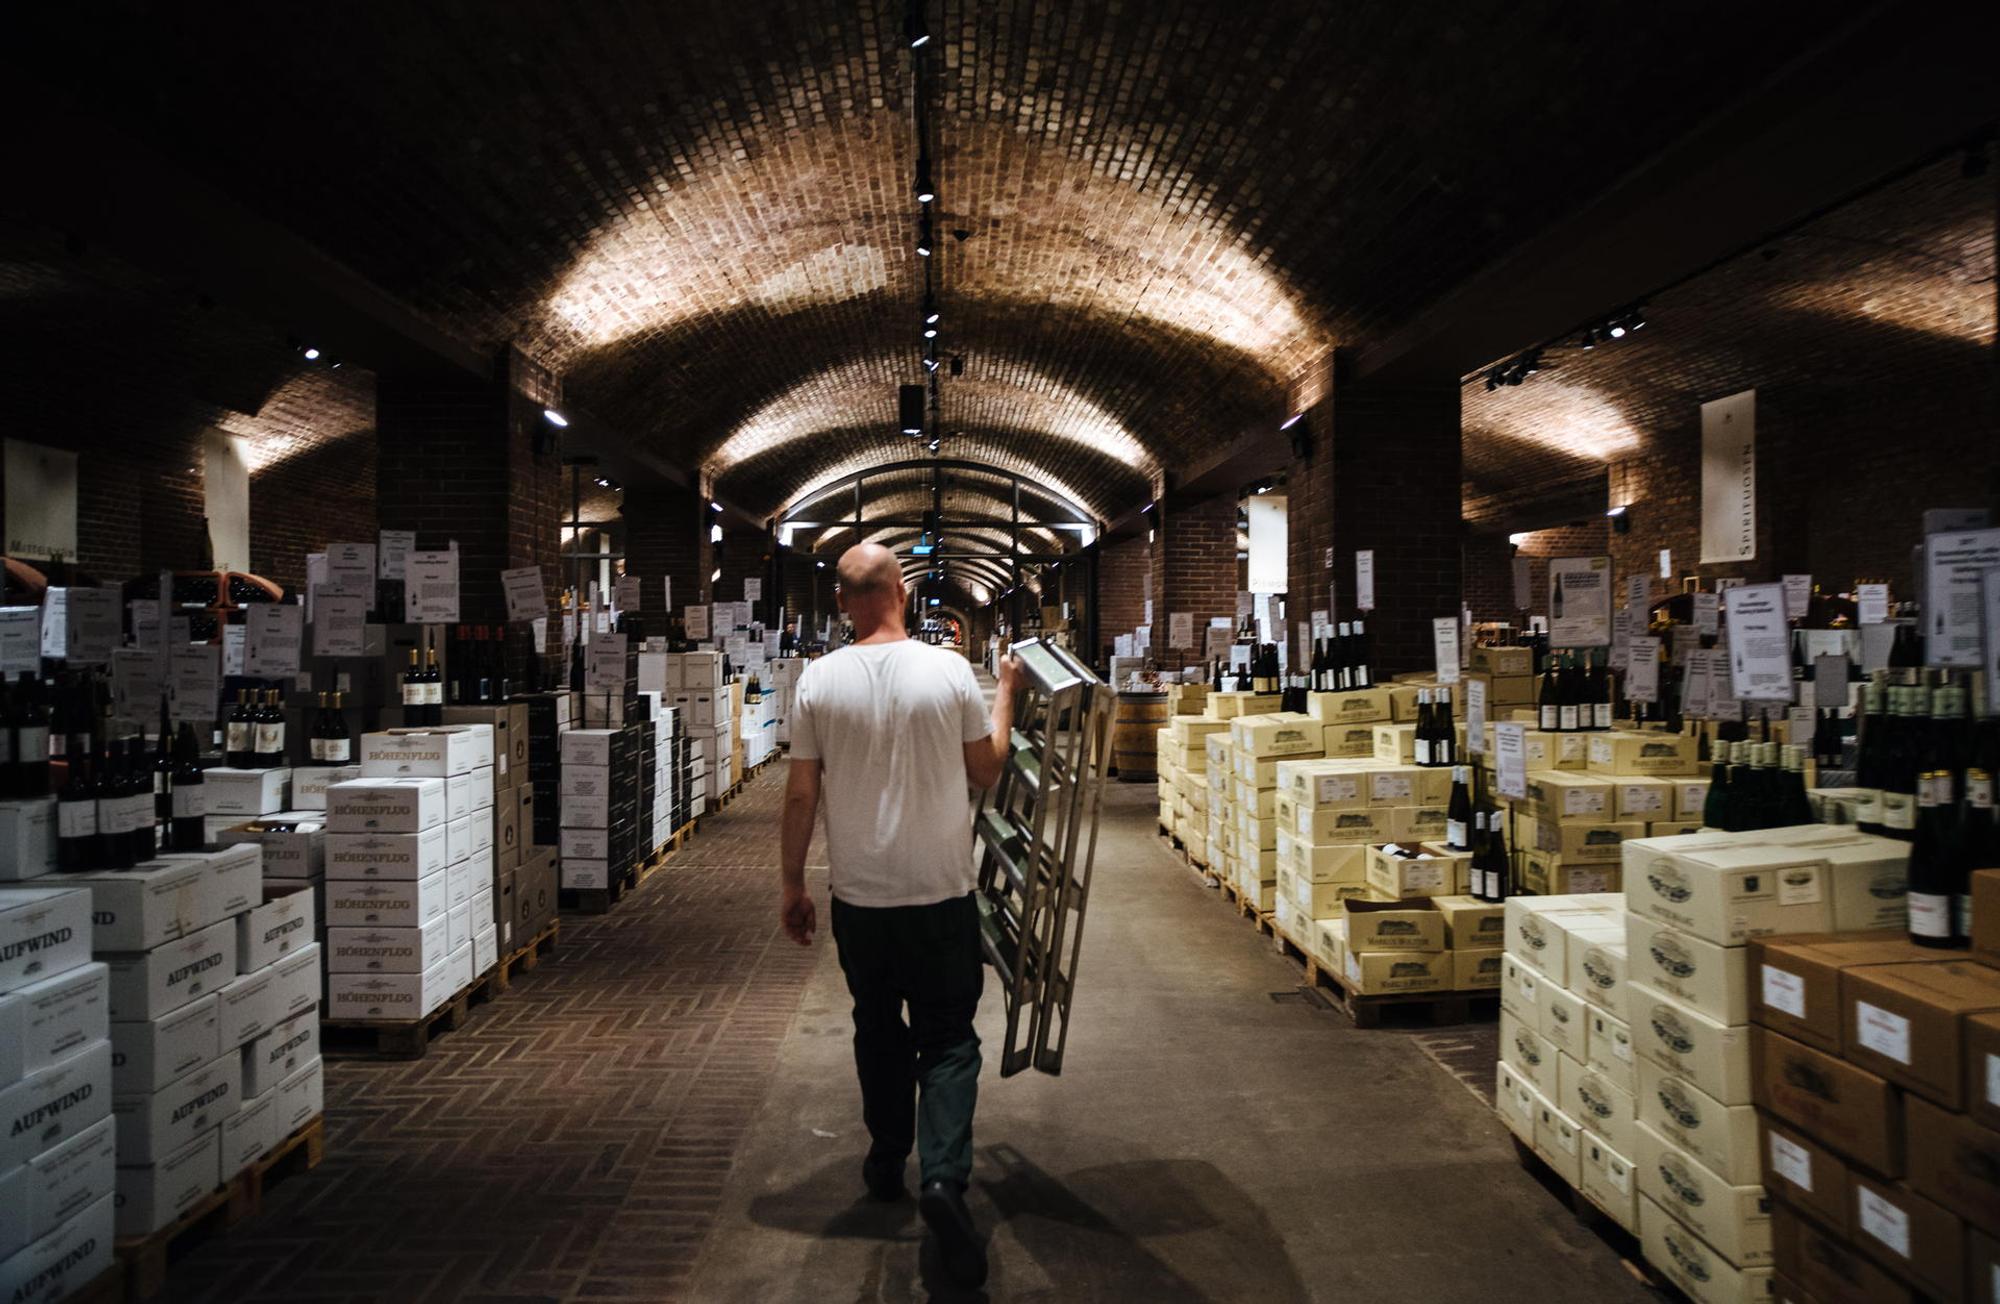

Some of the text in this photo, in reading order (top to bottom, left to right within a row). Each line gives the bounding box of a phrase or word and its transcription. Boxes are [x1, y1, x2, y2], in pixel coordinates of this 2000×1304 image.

[1739, 443, 1752, 555] SPIRITUOSEN
[368, 750, 440, 762] HÖHENFLUG
[334, 804, 410, 816] HÖHENFLUG
[333, 851, 410, 864] HÖHENFLUG
[334, 899, 410, 910] HÖHENFLUG
[263, 916, 304, 944] AUFWIND
[336, 945, 413, 957] HÖHENFLUG
[166, 952, 223, 987] AUFWIND
[337, 992, 413, 1004] HÖHENFLUG
[269, 1030, 310, 1064] AUFWIND
[10, 1084, 92, 1137] AUFWIND
[171, 1082, 228, 1125] AUFWIND
[11, 1238, 95, 1304] AUFWIND
